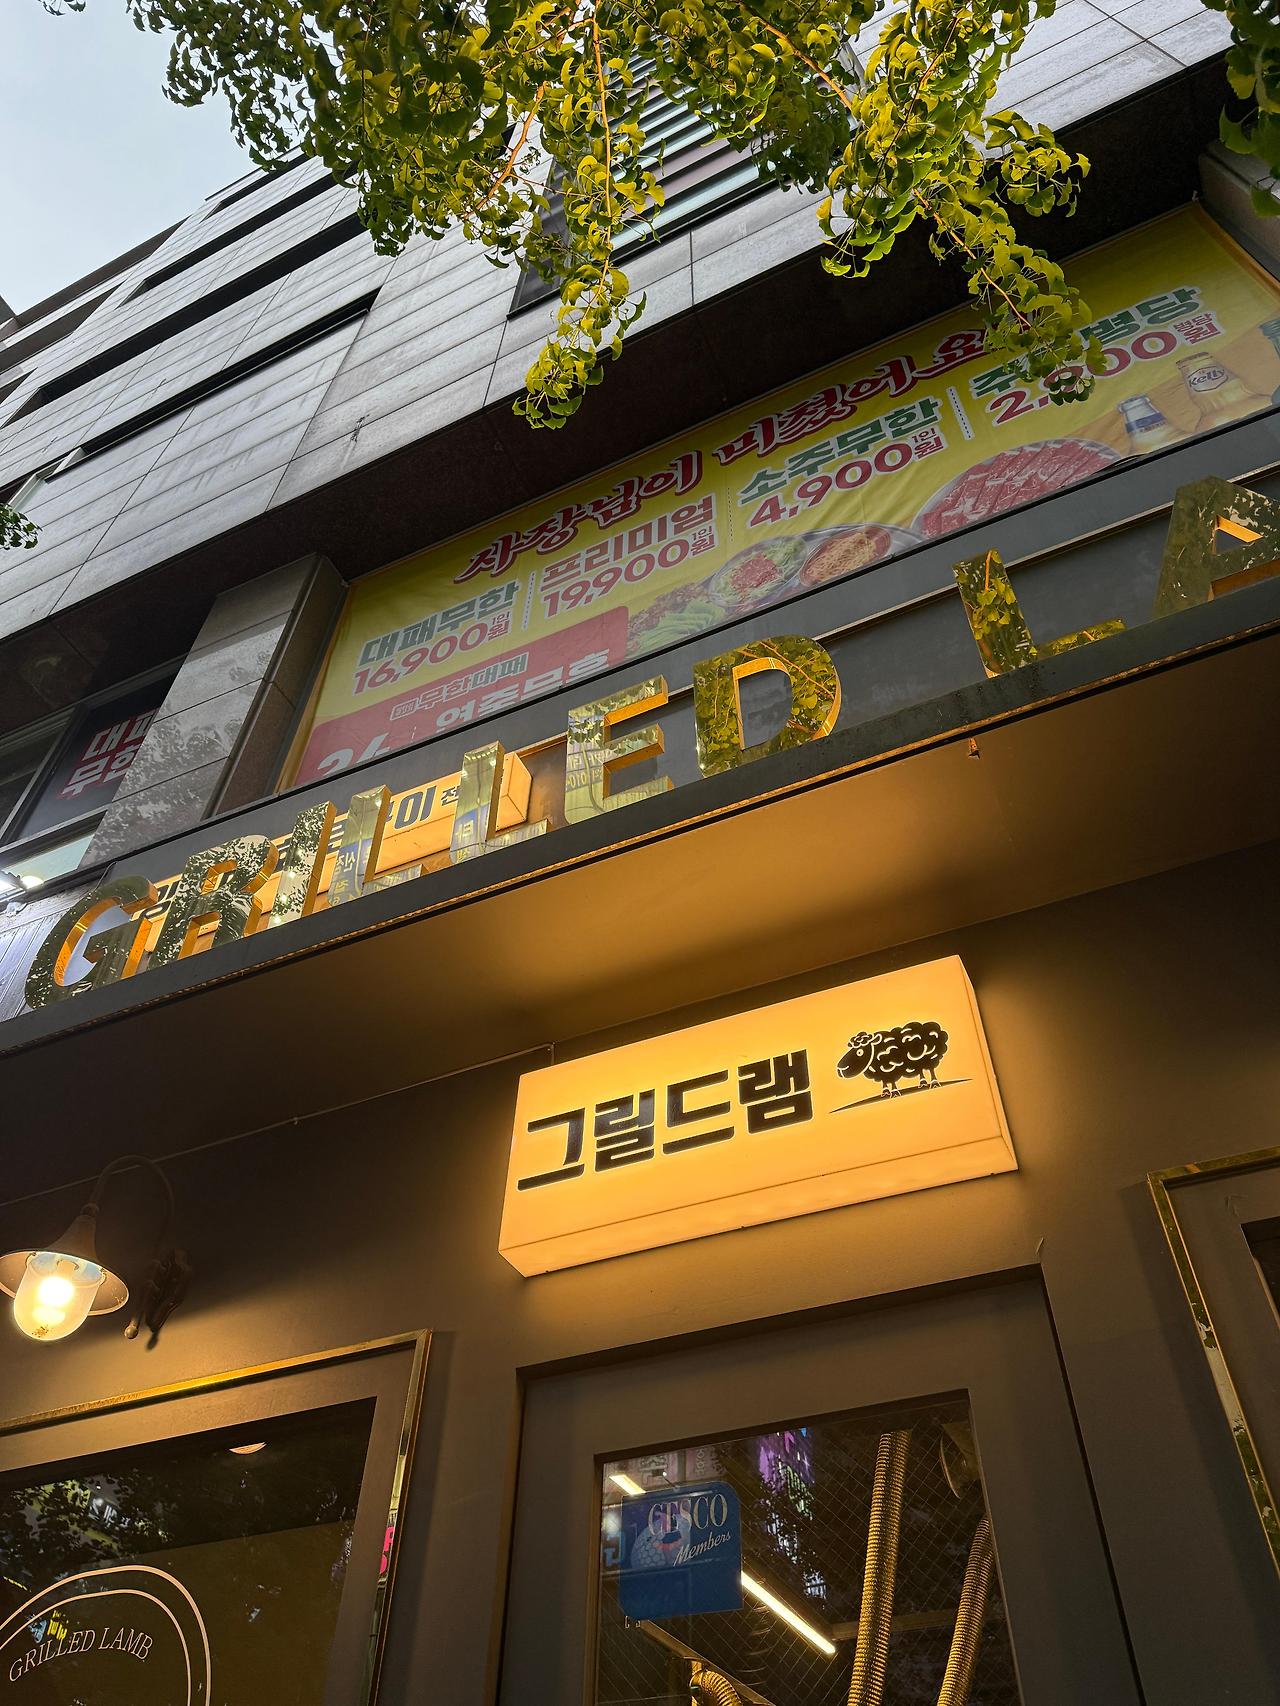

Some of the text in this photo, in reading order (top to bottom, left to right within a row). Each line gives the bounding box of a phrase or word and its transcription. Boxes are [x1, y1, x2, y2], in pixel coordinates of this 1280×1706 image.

[738, 397, 943, 506] 소주무한
[453, 450, 703, 585] 사장님이
[541, 494, 714, 592] 프리미엄
[542, 538, 691, 619] 19,900
[352, 622, 489, 696] 16,900
[358, 579, 519, 666] 대패무한
[416, 651, 529, 709] 무한대패
[25, 633, 843, 1010] GRILLED
[516, 1047, 814, 1192] 그릴드램
[672, 1530, 732, 1568] Members
[8, 1629, 96, 1682] GRILLED
[98, 1626, 153, 1660] LAMB
